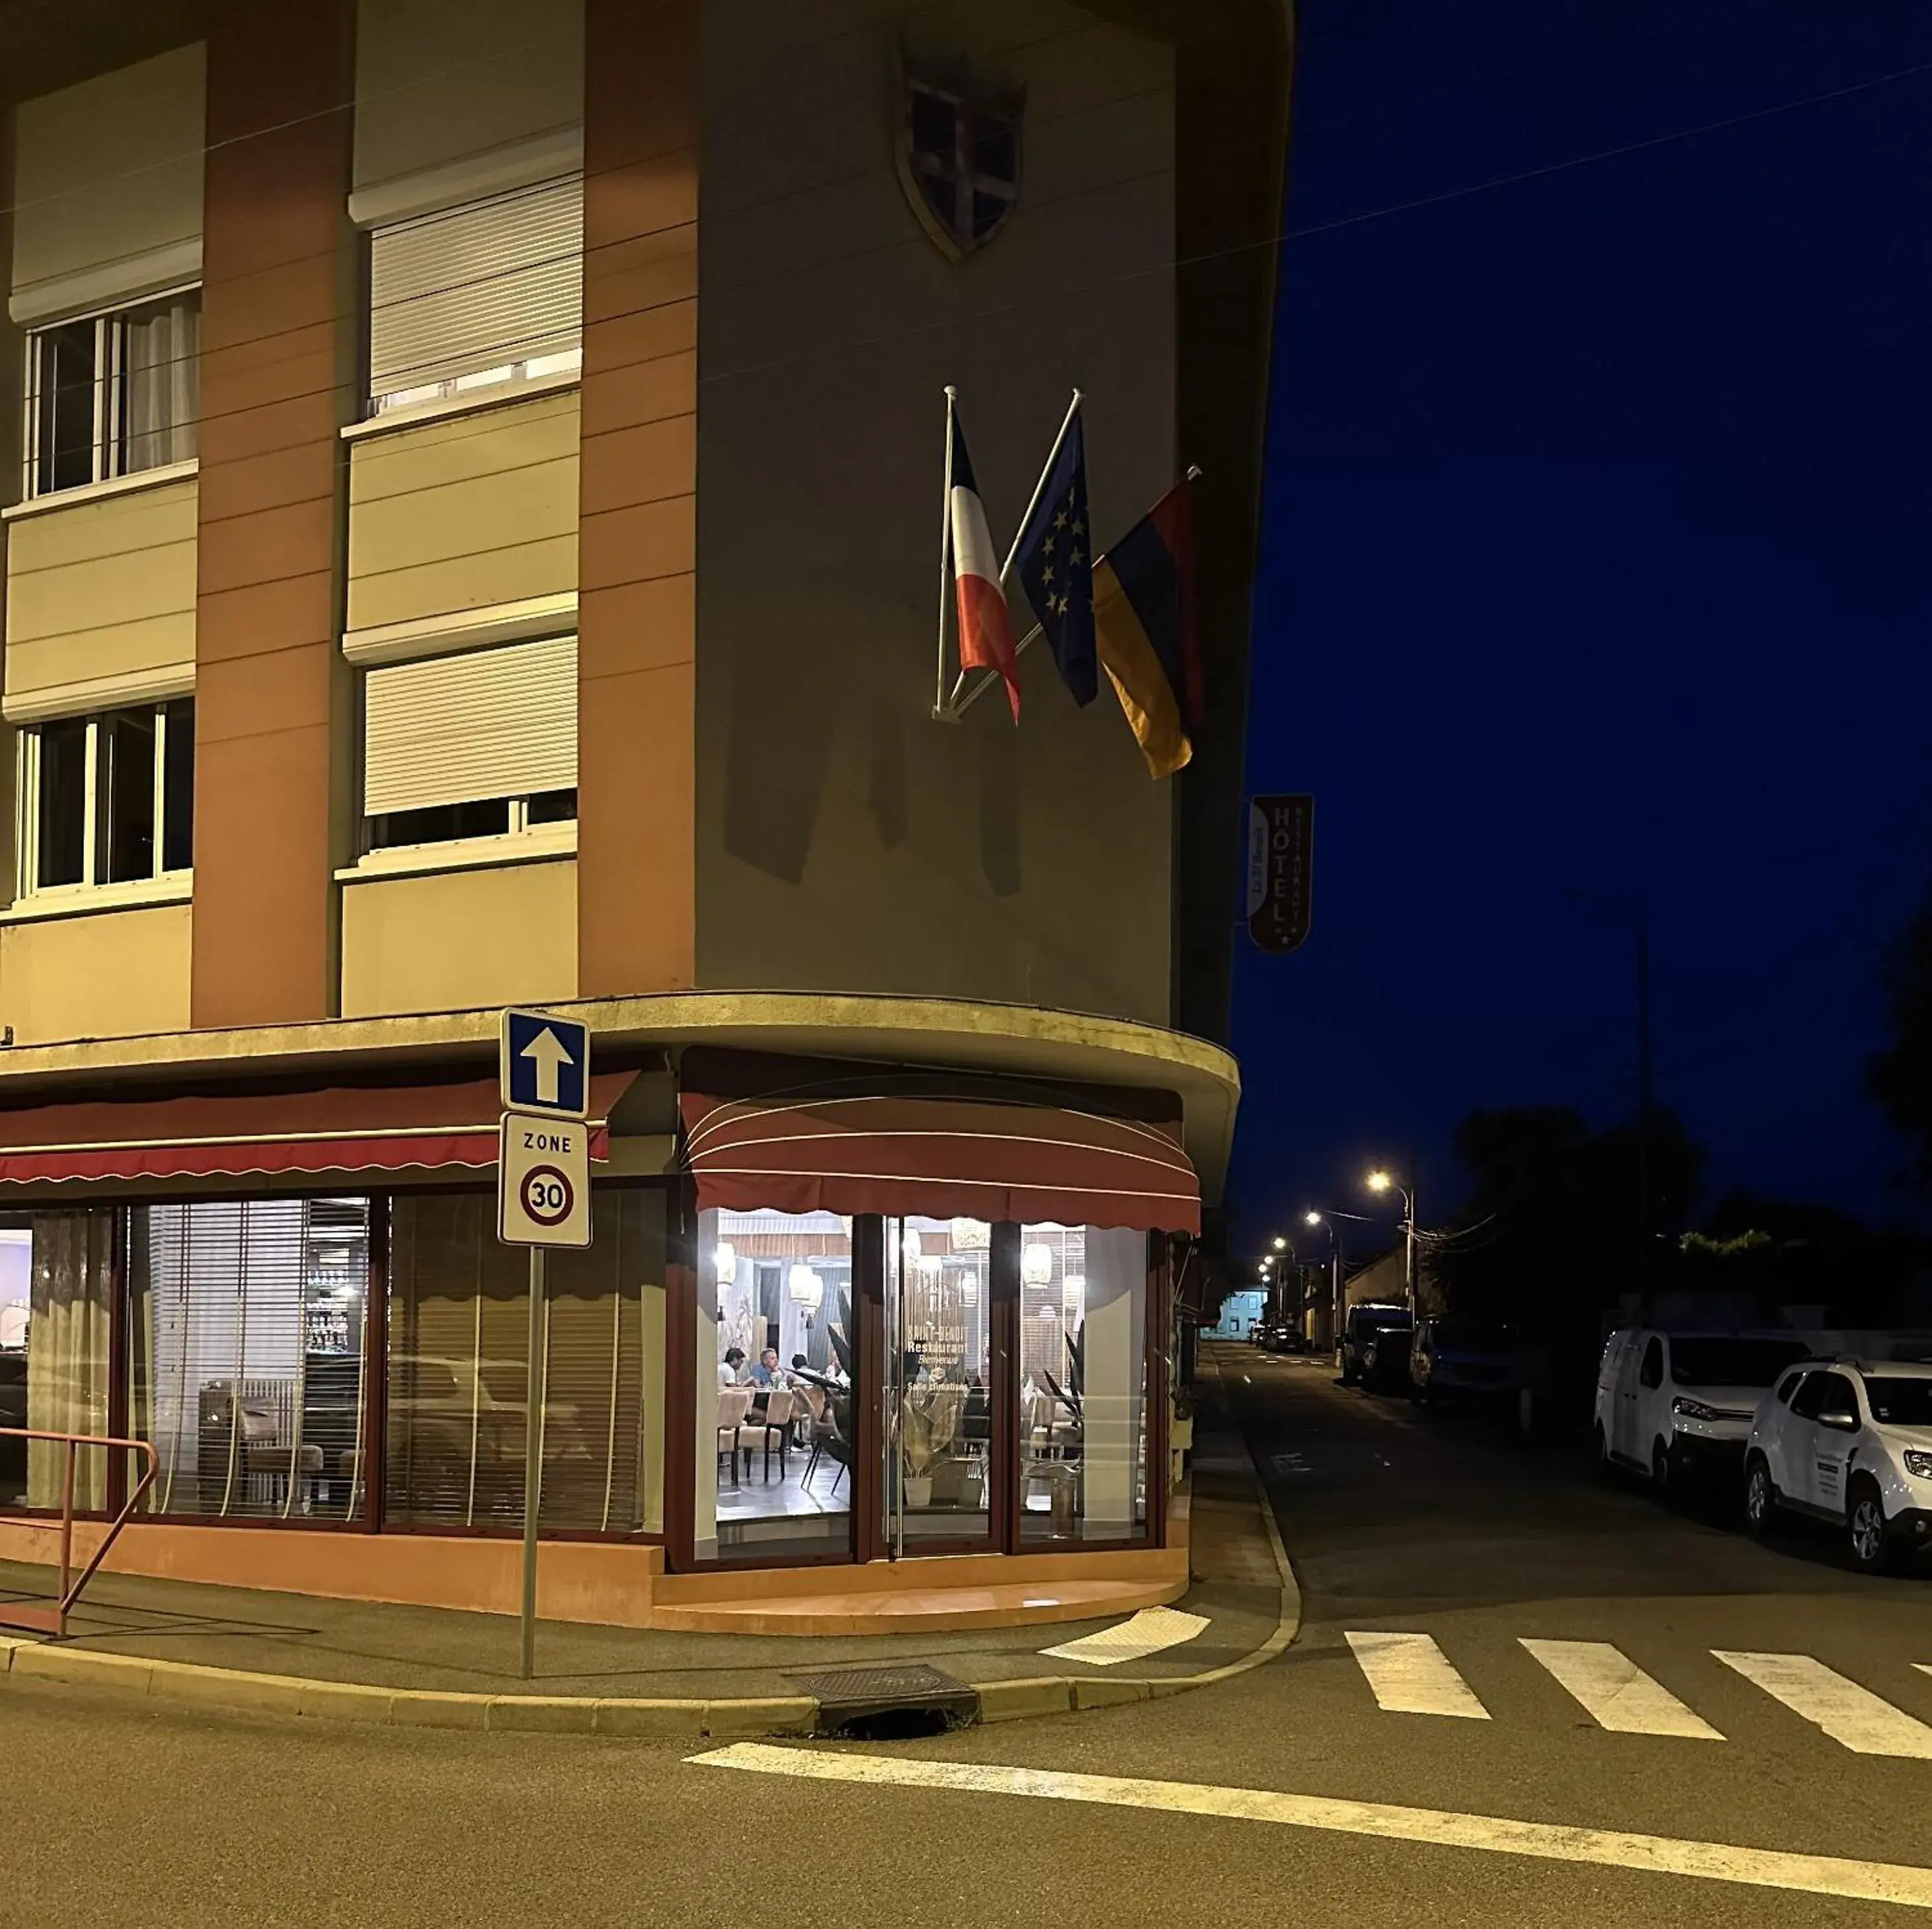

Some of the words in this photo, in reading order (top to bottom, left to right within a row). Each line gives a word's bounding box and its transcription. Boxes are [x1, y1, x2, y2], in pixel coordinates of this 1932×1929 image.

[523, 1133, 571, 1153] ZONE
[531, 1182, 563, 1209] 30
[908, 1341, 968, 1353] Restaurant
